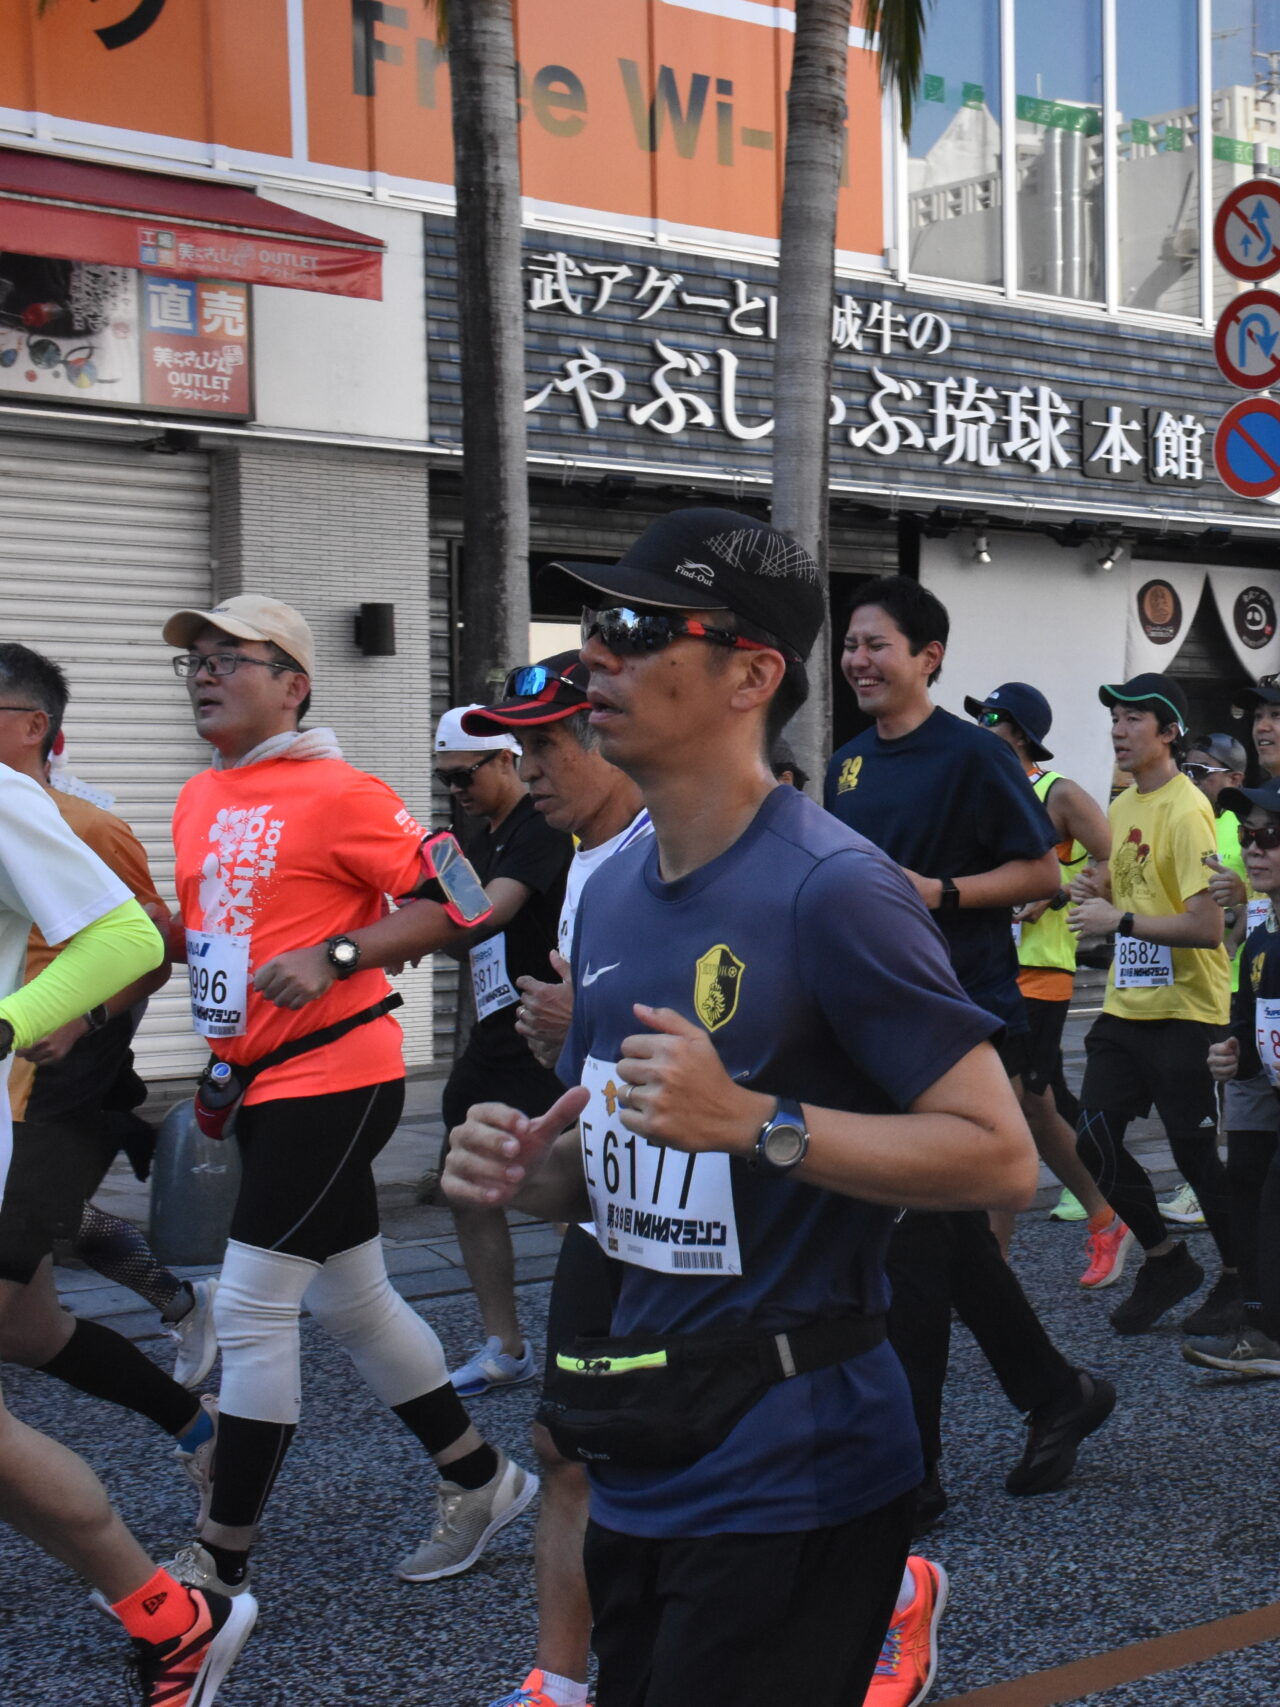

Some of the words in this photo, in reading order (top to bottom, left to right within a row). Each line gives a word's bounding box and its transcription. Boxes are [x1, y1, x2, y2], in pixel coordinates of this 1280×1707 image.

[352, 0, 588, 138] Fre
[617, 57, 850, 188] Wi-
[259, 250, 319, 269] OUTLET
[168, 371, 231, 390] OUTLET
[171, 387, 231, 403] アウトレット
[674, 564, 714, 587] Find-Out
[1119, 941, 1161, 965] 8582
[189, 966, 228, 1005] 996
[583, 1121, 596, 1188] E
